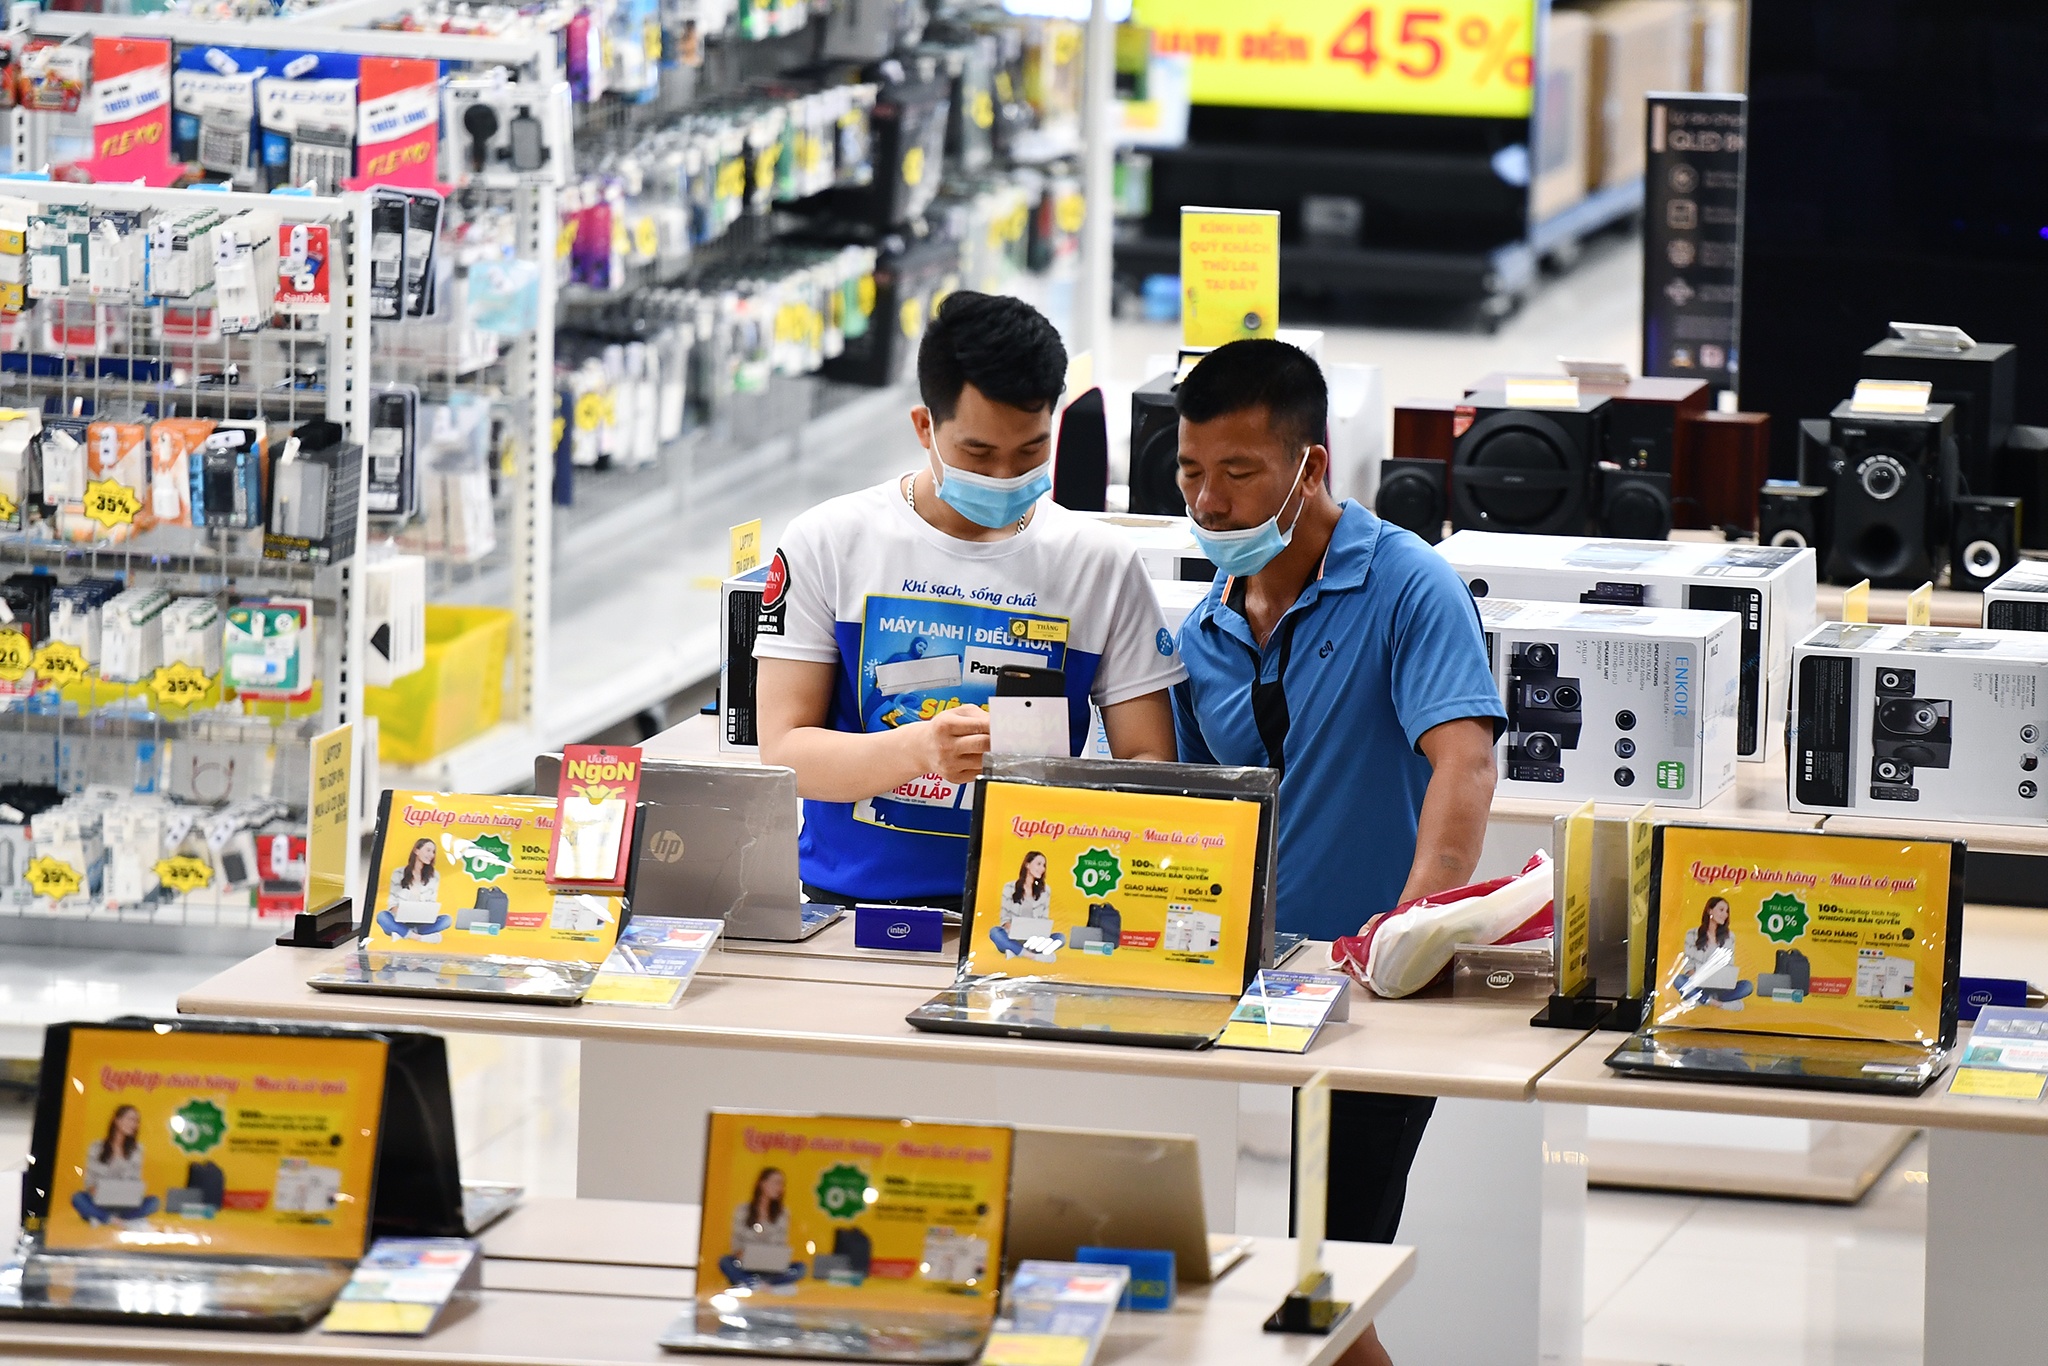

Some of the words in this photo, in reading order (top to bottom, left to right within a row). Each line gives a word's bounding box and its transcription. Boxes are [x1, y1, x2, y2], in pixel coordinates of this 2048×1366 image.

[1328, 6, 1535, 88] 45%
[902, 578, 927, 593] Khí
[930, 584, 965, 599] sạch,
[969, 586, 1003, 606] sống
[1006, 591, 1038, 607] chất
[879, 615, 917, 634] MÁY
[918, 620, 964, 640] LẠNH
[1652, 643, 1660, 687] SPECIFICATIONS
[1673, 655, 1690, 717] ENKOR
[567, 759, 636, 785] NgoN
[919, 780, 952, 800] LẮP
[403, 805, 456, 828] Laptop
[458, 813, 489, 825] chính
[491, 815, 523, 831] hãng
[535, 815, 554, 829] Mu
[1012, 815, 1065, 840] Laptop
[1067, 824, 1099, 837] chính
[1101, 826, 1132, 843] hãng
[1144, 828, 1169, 843] Mua
[1171, 831, 1183, 844] là
[1185, 832, 1199, 845] có
[1201, 834, 1225, 850] quà
[651, 830, 684, 862] hp
[1082, 868, 1111, 887] 0%
[1131, 870, 1167, 878] WINDOWS
[1691, 860, 1748, 886] Laptop
[1750, 869, 1783, 883] chính
[1785, 870, 1818, 889] hãng
[1830, 872, 1857, 887] Mua
[1859, 874, 1873, 888] là
[1874, 875, 1889, 889] có
[1890, 877, 1917, 892] quà
[1124, 883, 1143, 891] GIAO
[1145, 884, 1169, 893] HÀNG
[1818, 903, 1844, 914] 100%
[1845, 907, 1870, 916] Laptop
[1818, 914, 1856, 923] WINDOWS
[1767, 913, 1798, 933] 0%
[1811, 928, 1832, 937] GIAO
[1833, 928, 1858, 938] HÀNG
